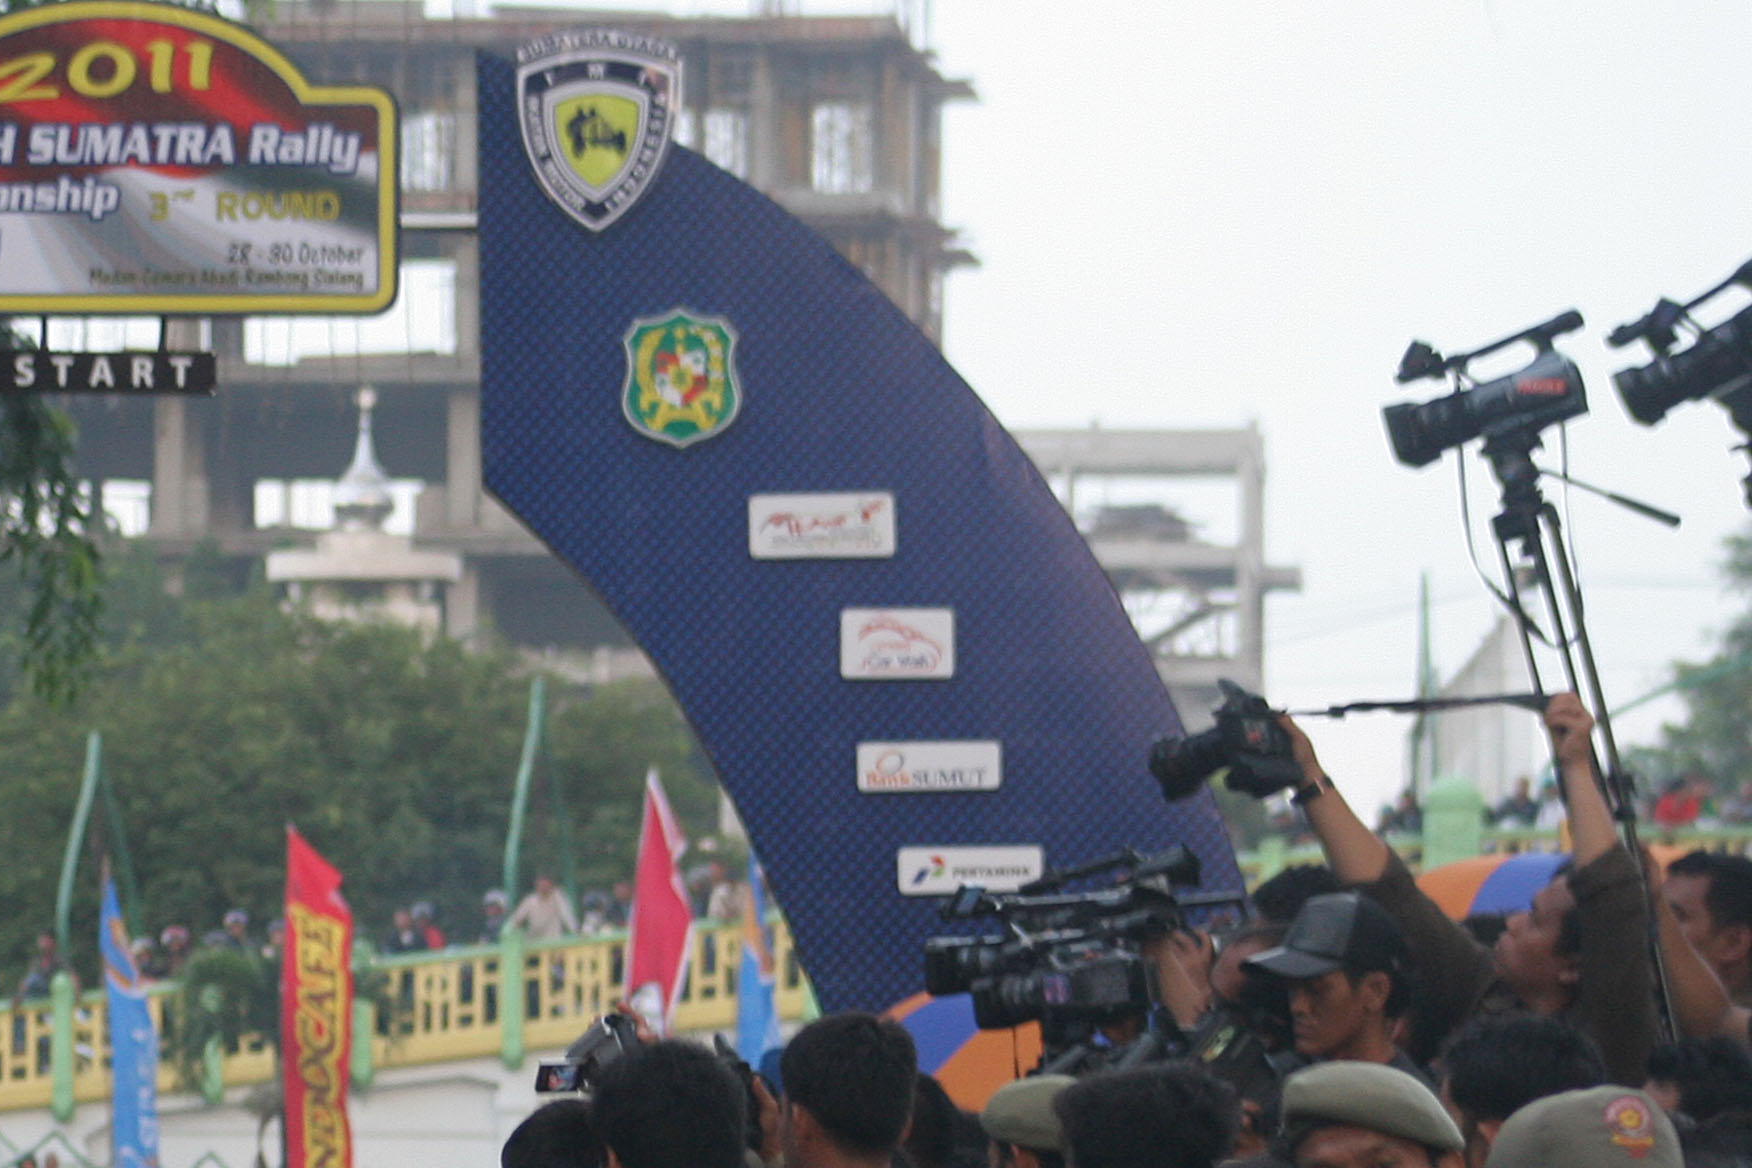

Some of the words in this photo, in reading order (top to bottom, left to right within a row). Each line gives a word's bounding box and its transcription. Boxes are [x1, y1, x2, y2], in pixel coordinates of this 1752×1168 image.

[27, 122, 235, 166] SUMATRA
[248, 123, 362, 175] Rally
[215, 189, 341, 222] ROUND
[268, 243, 293, 265] 30
[298, 243, 364, 265] October
[14, 356, 194, 390] START
[911, 767, 987, 785] SUMUT
